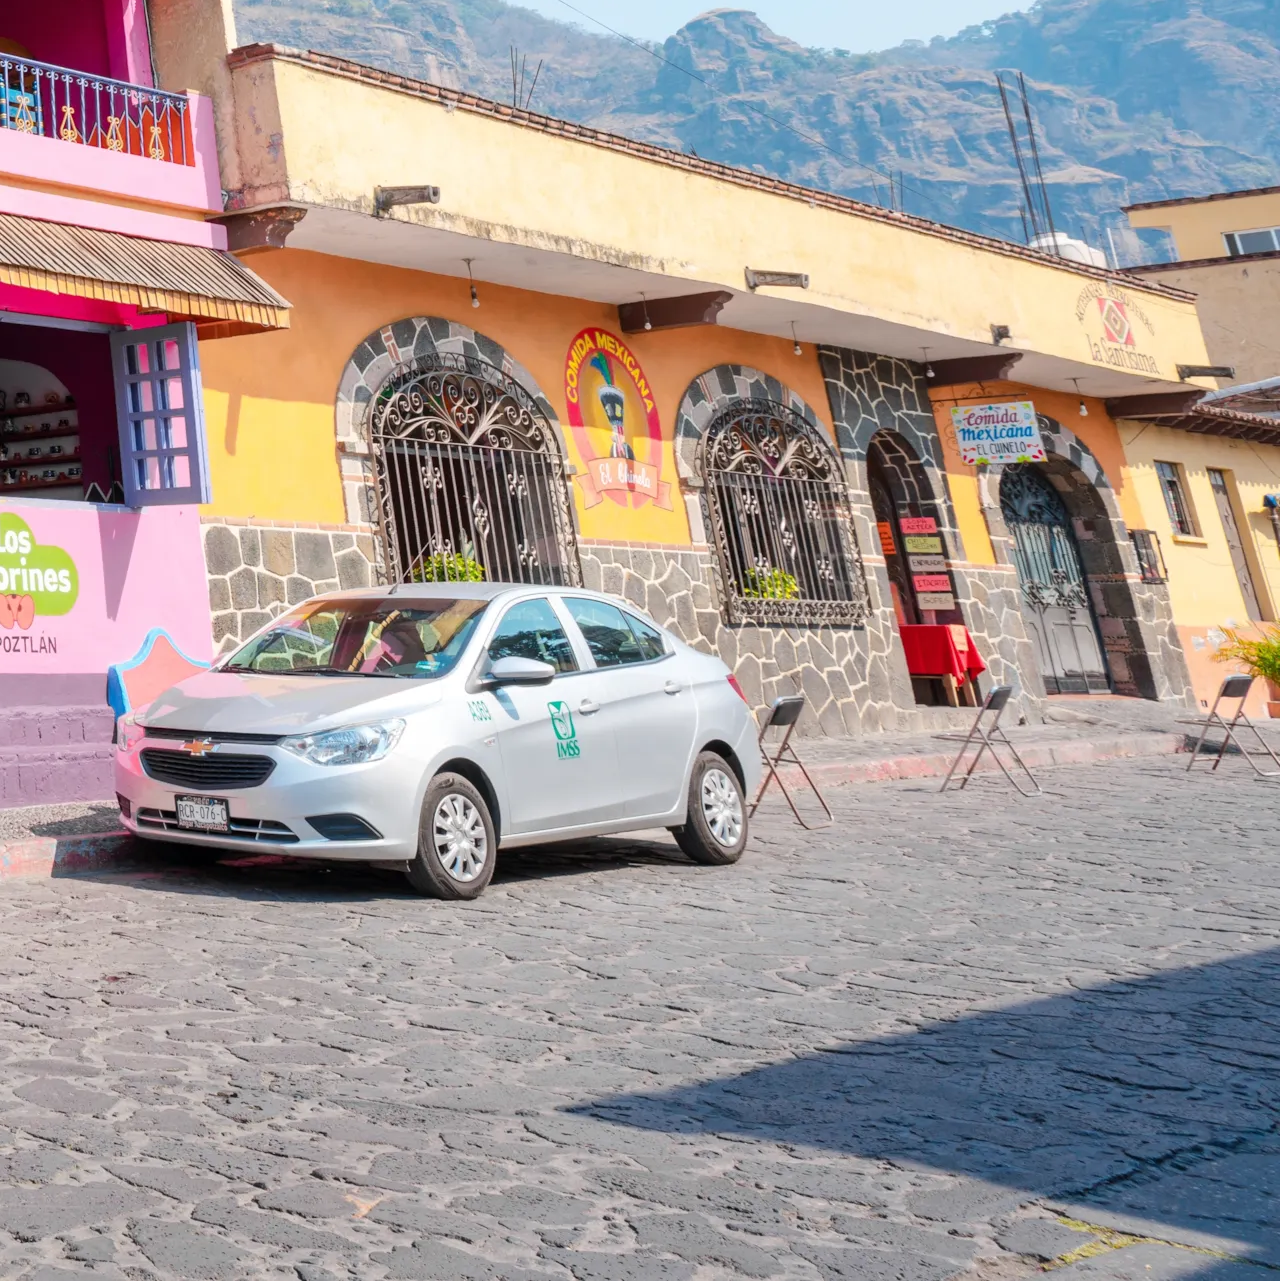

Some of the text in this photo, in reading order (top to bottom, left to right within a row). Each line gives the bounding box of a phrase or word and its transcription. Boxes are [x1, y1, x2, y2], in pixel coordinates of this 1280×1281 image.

[566, 331, 655, 414] COMIDA MEXICANA
[962, 409, 1020, 426] Comida
[959, 425, 1034, 442] mexicana
[976, 442, 1027, 455] EL CHINELO
[599, 463, 612, 485] El
[467, 700, 492, 722] A369
[556, 740, 581, 758] IMSS
